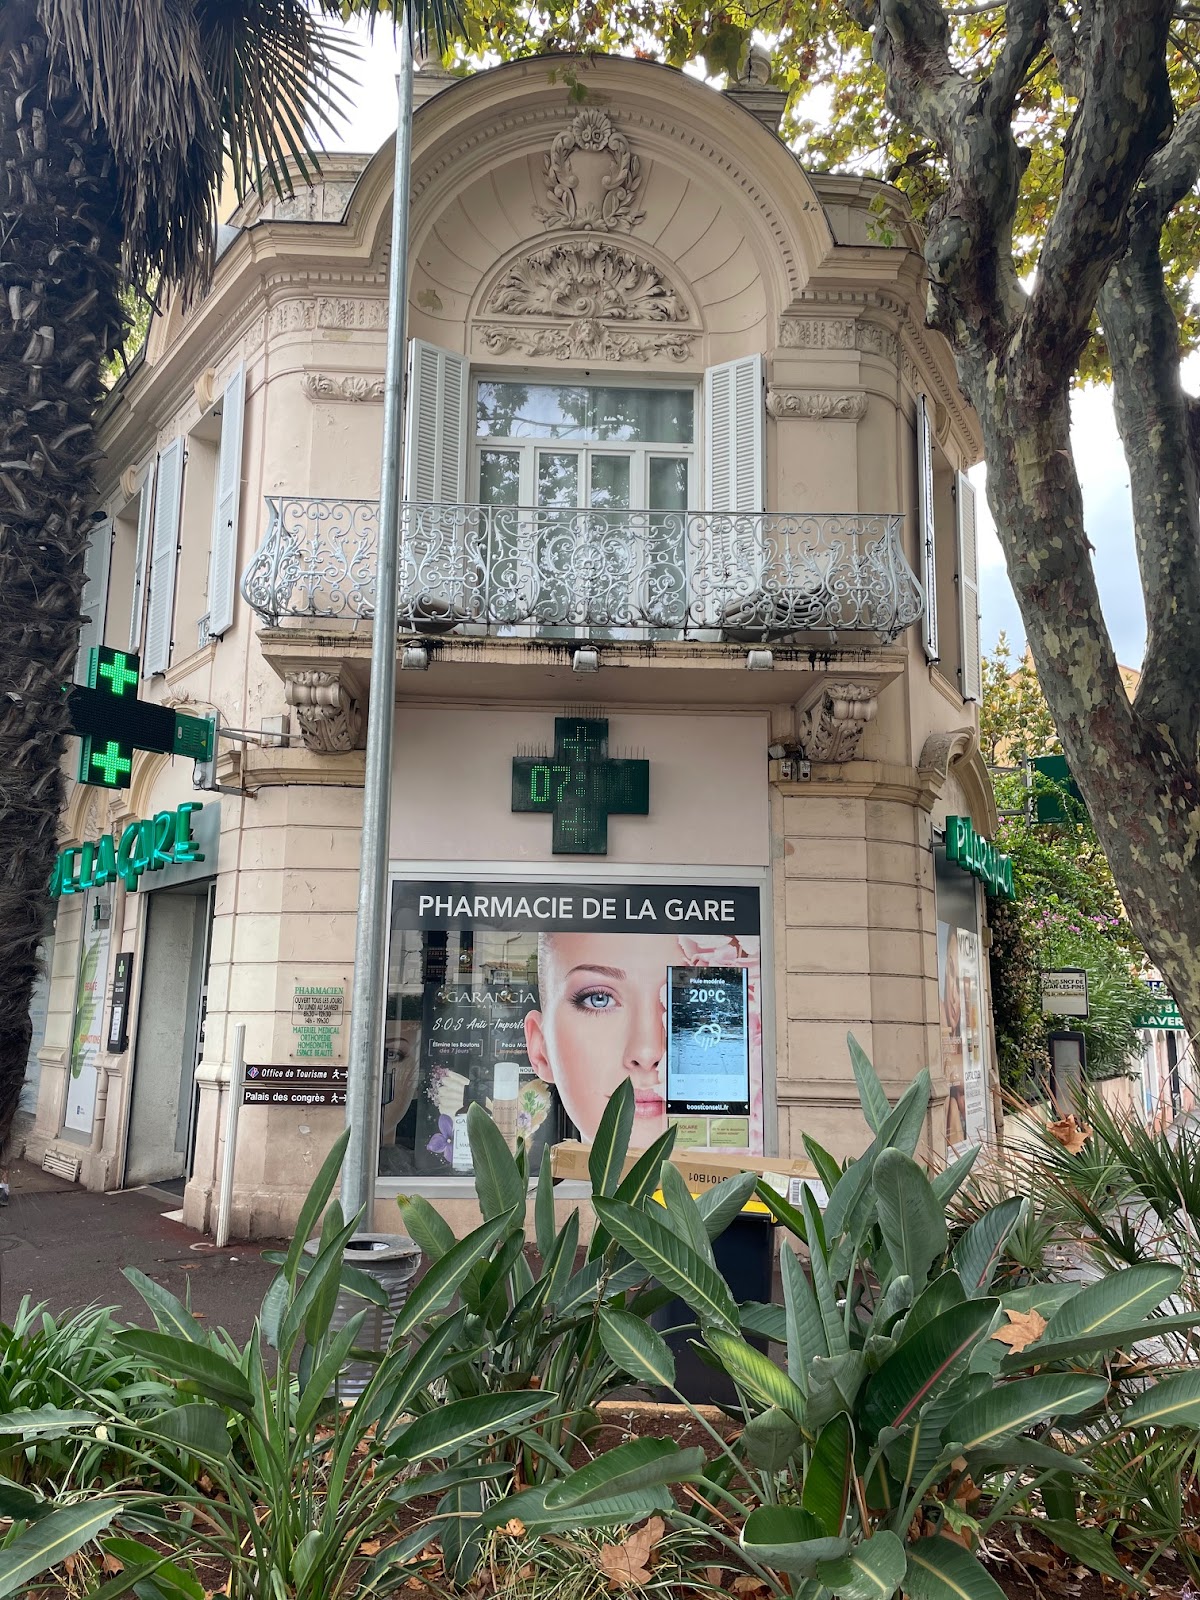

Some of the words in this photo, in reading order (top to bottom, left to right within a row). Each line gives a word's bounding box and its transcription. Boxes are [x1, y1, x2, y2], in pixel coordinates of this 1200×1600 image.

[117, 802, 206, 892] GARE
[418, 895, 574, 919] PHARMACIE
[582, 898, 617, 919] DE
[624, 899, 657, 920] LA
[664, 899, 735, 921] GARE
[704, 978, 725, 986] modérée
[294, 987, 344, 995] PHARMACIEN
[261, 1068, 283, 1078] Office
[285, 1069, 294, 1078] de
[297, 1070, 328, 1079] Tourisme
[245, 1092, 269, 1101] Palais
[272, 1092, 288, 1101] des
[291, 1093, 325, 1104] congrès
[687, 1103, 730, 1111] boostconseil.fr
